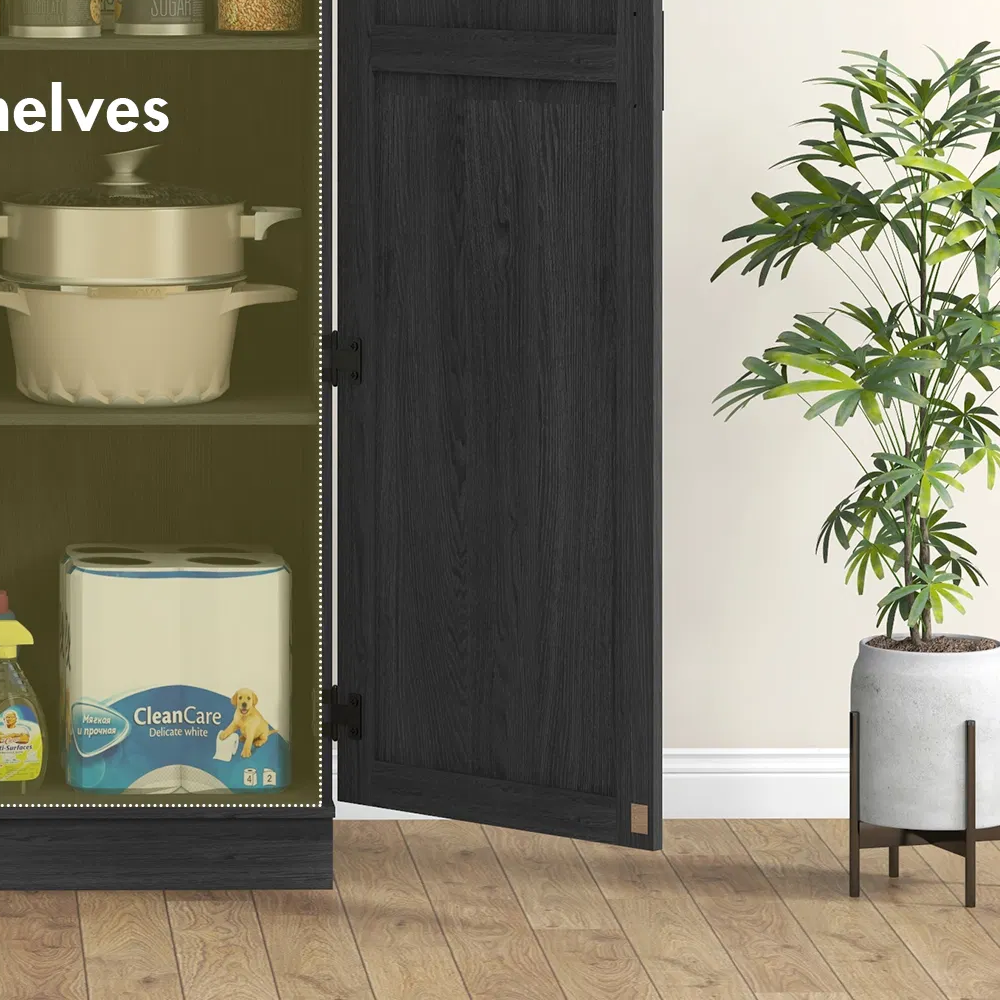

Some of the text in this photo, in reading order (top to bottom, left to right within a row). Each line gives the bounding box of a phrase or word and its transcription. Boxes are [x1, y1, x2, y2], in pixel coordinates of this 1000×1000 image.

[82, 714, 111, 725] Мягкая
[133, 705, 222, 726] CleanCare
[83, 727, 117, 738] прочная
[149, 727, 208, 738] Delicate white
[246, 775, 252, 784] 4
[267, 774, 272, 783] 2
